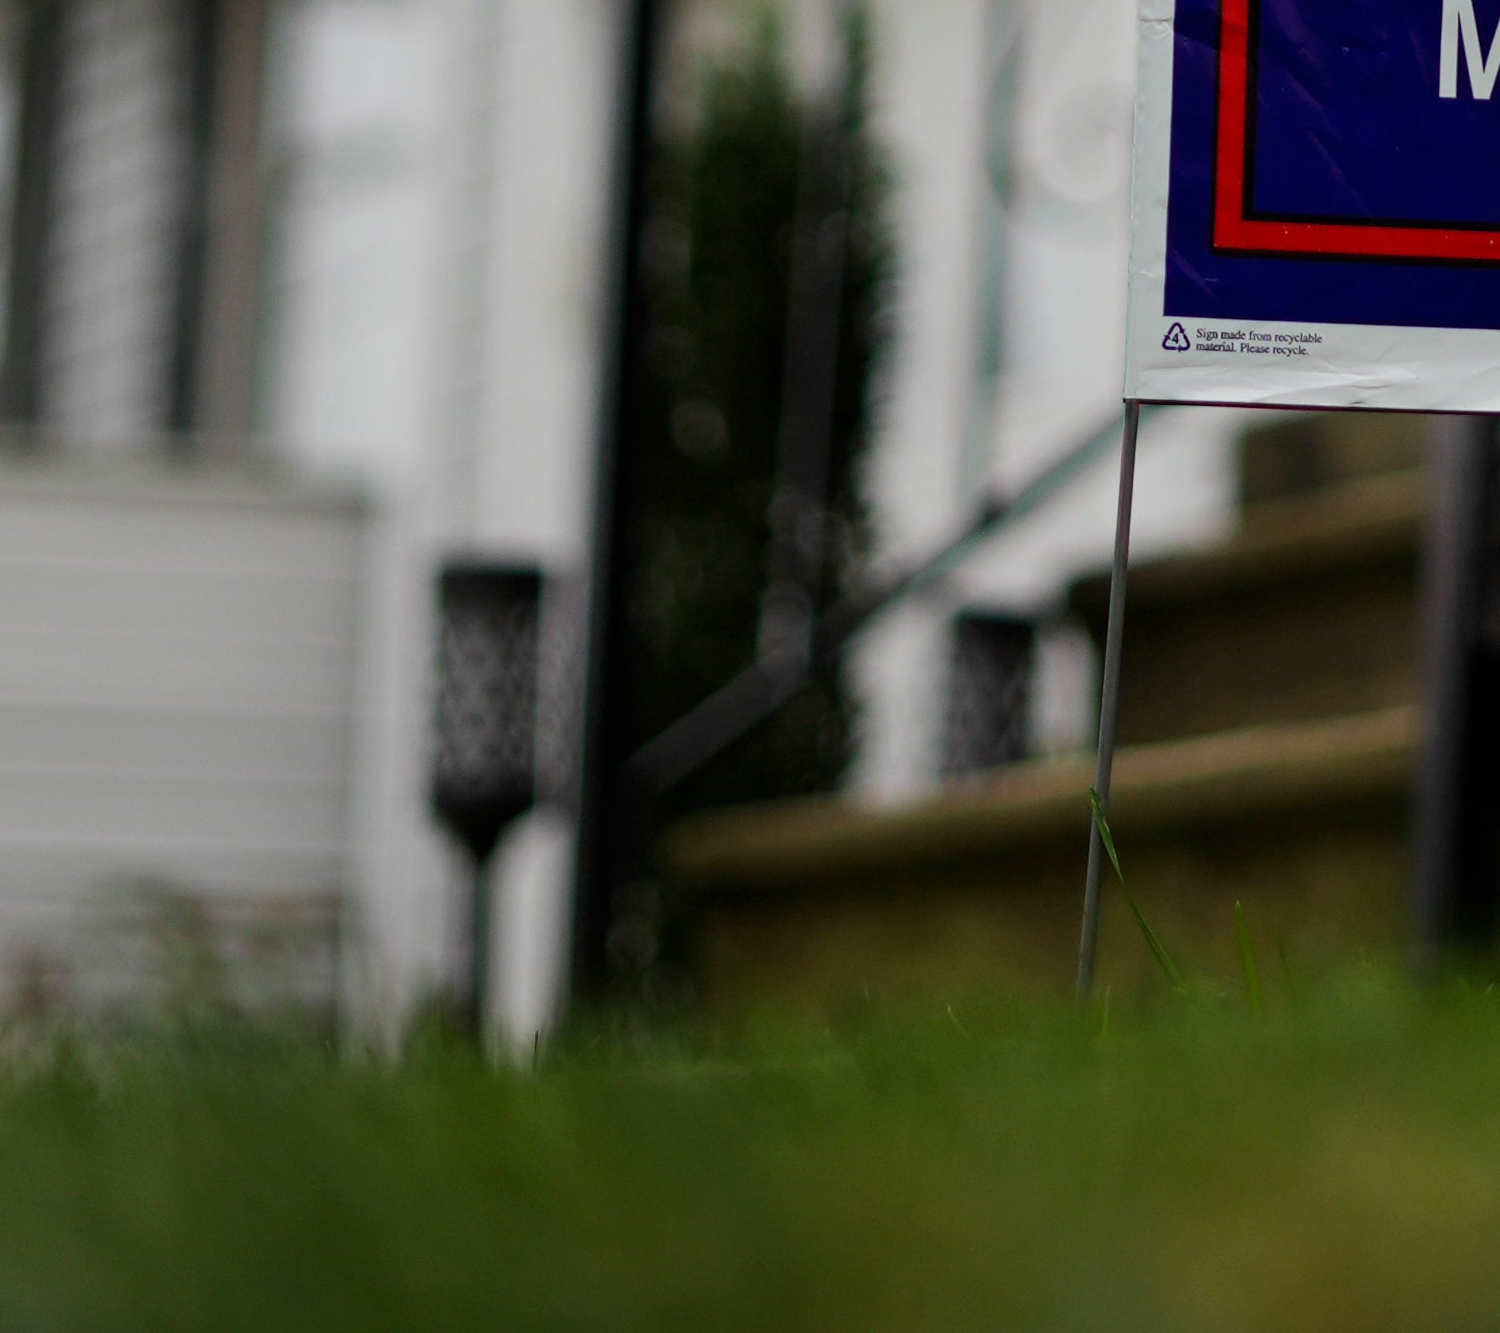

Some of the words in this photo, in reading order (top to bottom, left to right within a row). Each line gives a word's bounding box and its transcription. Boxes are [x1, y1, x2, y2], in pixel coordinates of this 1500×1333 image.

[1196, 328, 1218, 341] Sign
[1221, 330, 1246, 340] made
[1249, 330, 1272, 341] from
[1274, 332, 1322, 344] recyclable
[1196, 341, 1236, 352] material.
[1240, 343, 1270, 354] Please
[1273, 344, 1309, 356] recycle.
